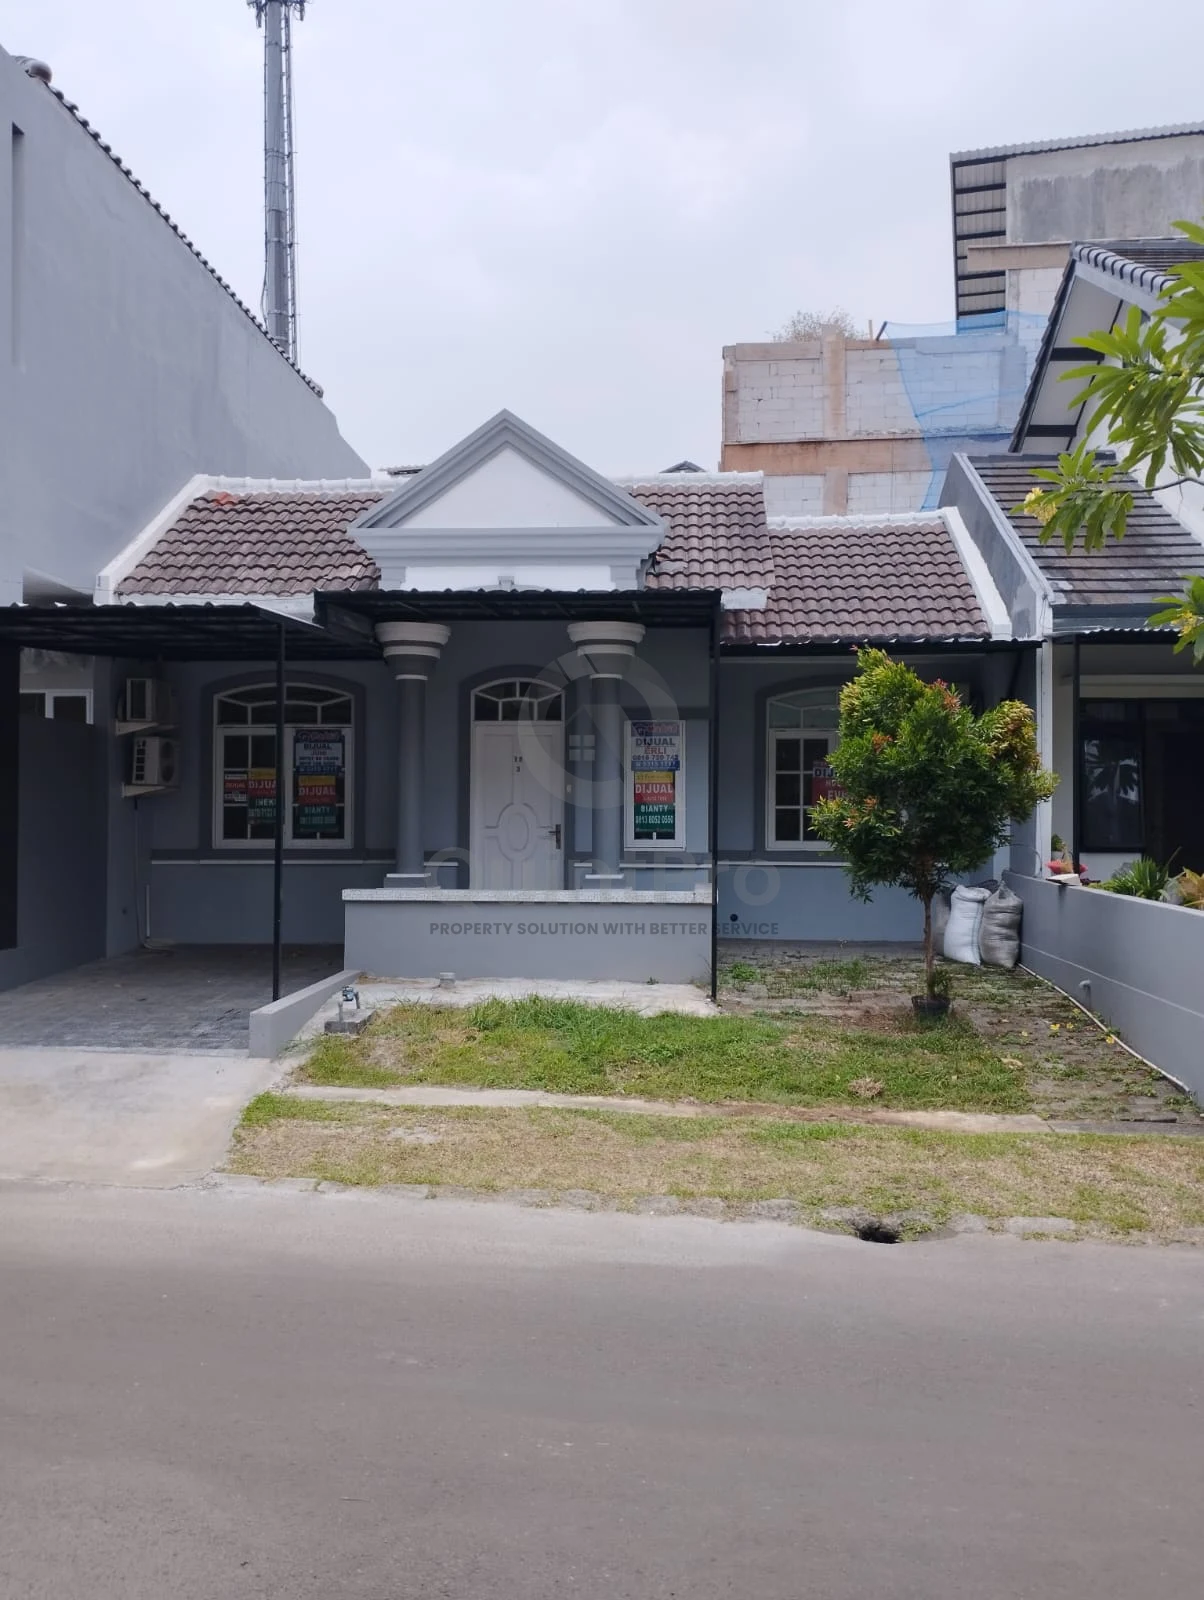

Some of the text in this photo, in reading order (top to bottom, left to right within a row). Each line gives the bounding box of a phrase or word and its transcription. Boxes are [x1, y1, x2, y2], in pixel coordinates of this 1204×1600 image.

[636, 738, 676, 746] DIJUAL
[299, 786, 336, 796] DIJUAL
[635, 783, 673, 794] DIJUAL
